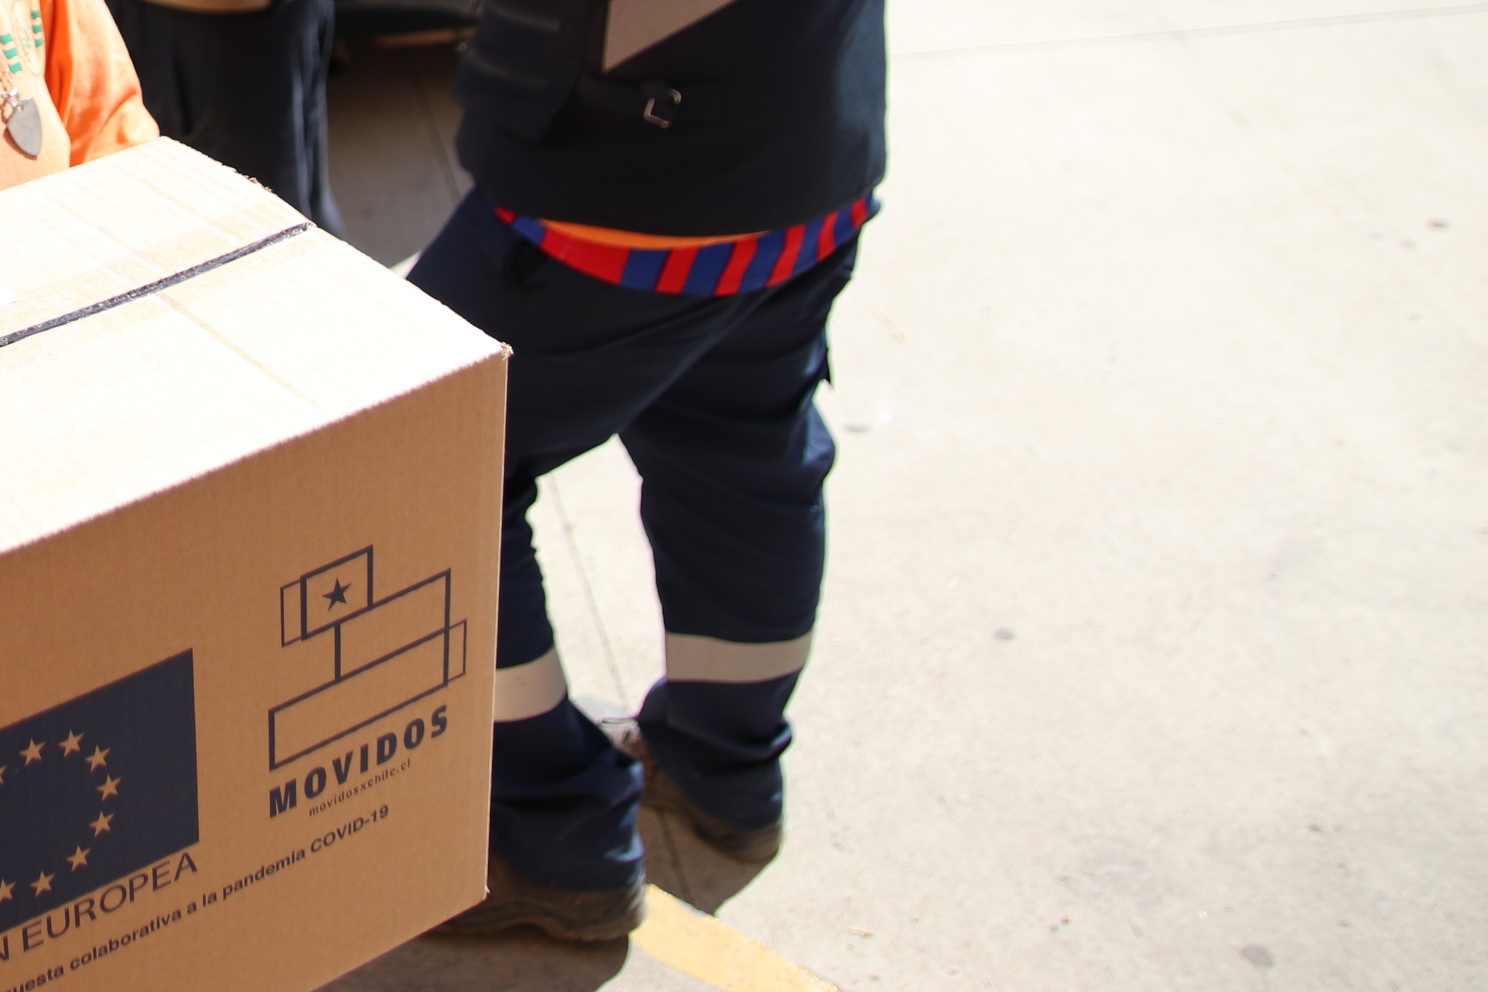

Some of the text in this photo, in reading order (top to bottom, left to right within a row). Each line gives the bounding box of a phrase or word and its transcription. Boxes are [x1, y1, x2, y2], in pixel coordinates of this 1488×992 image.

[269, 704, 448, 819] MOVIDOS
[308, 757, 411, 817] movidosxchile.cl
[5, 805, 389, 992] uesta colaborativa a la pandemia COVID-19
[21, 851, 198, 952] EUROPEA
